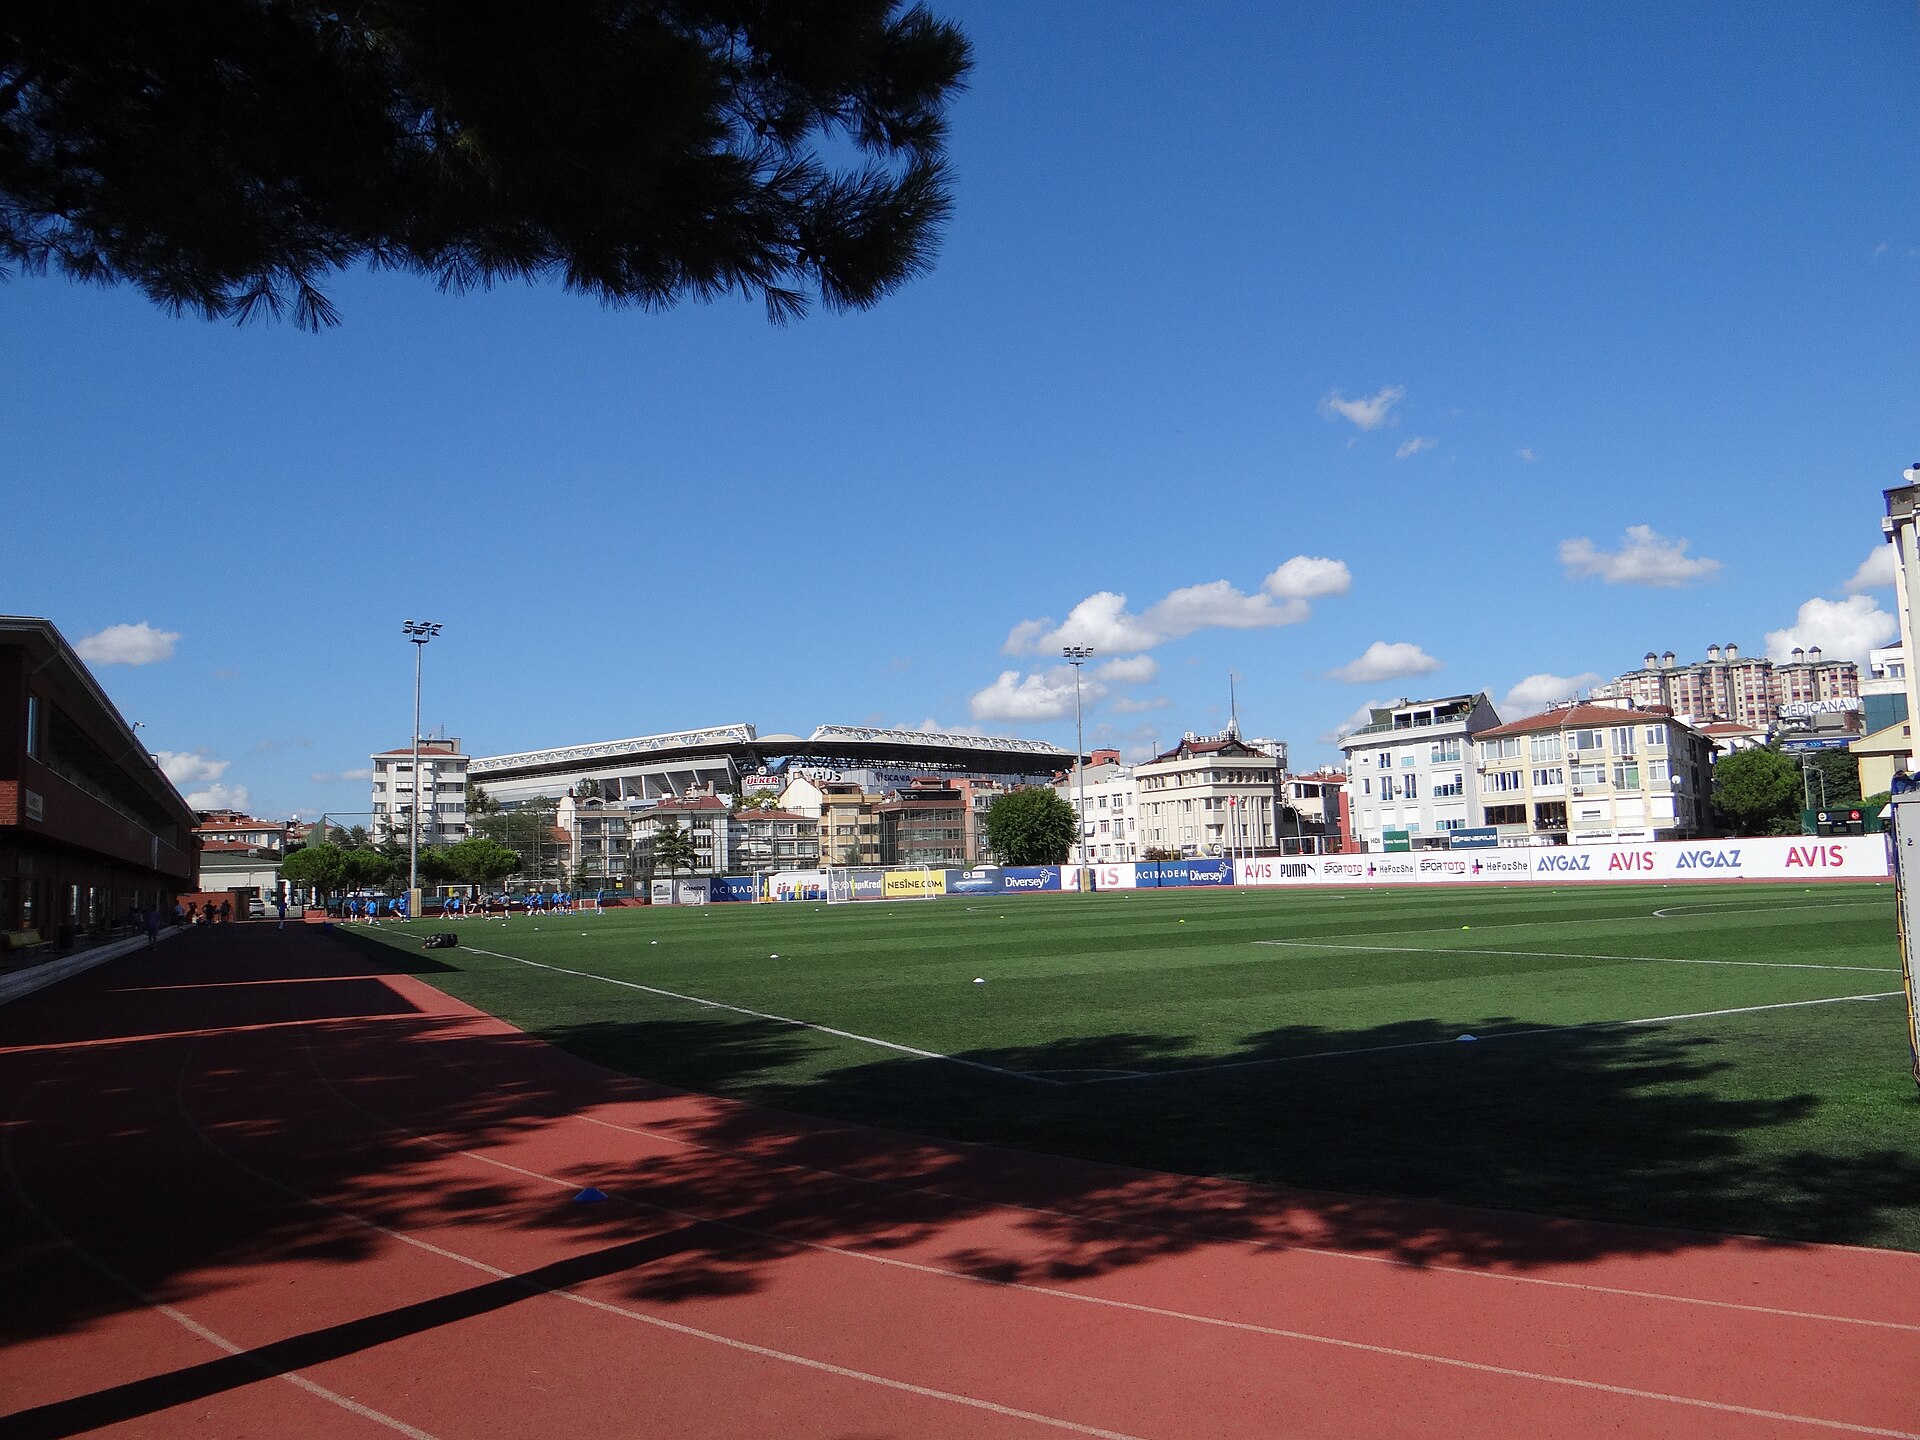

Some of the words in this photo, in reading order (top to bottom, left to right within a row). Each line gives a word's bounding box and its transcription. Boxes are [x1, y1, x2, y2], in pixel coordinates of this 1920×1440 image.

[1780, 700, 1847, 716] MEDICANA
[746, 775, 778, 785] ÜLKER
[1536, 854, 1590, 871] AYGAZ
[1608, 851, 1654, 871] AVIS
[1675, 849, 1742, 868] AYGAZ
[1784, 845, 1844, 867] AVIS
[1245, 864, 1271, 878] AVIS
[1280, 863, 1307, 877] PUMA
[1379, 864, 1414, 873] HeForShe
[1486, 861, 1528, 871] HeForShe
[1136, 869, 1188, 879] ACIBADEM
[1189, 870, 1223, 883] Diversey
[1005, 876, 1044, 888] Diversey
